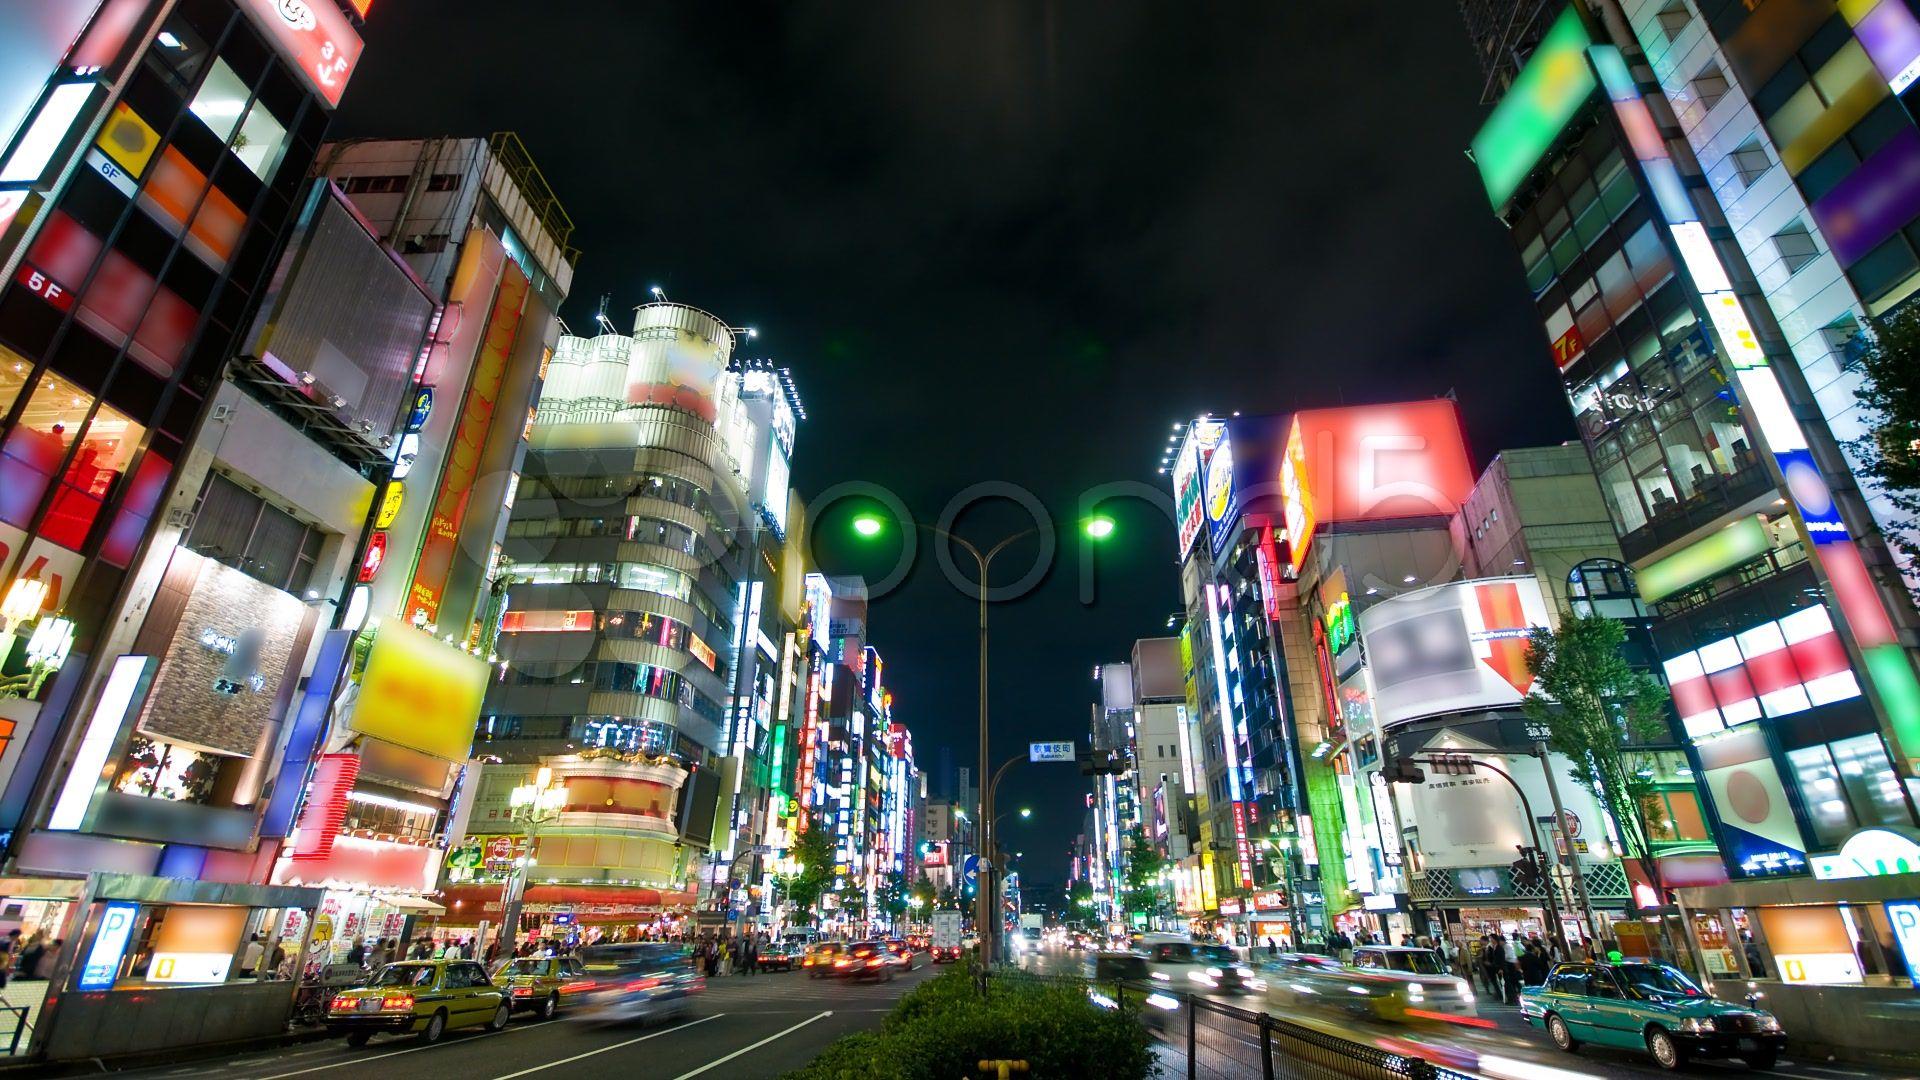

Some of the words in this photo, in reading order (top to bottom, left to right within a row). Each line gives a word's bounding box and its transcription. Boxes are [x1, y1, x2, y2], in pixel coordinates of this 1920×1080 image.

[321, 41, 348, 73] 3F
[100, 162, 121, 181] 6F
[28, 271, 62, 301] 5F
[1554, 335, 1577, 361] 7F
[103, 913, 125, 940] P
[1896, 911, 1916, 938] P
